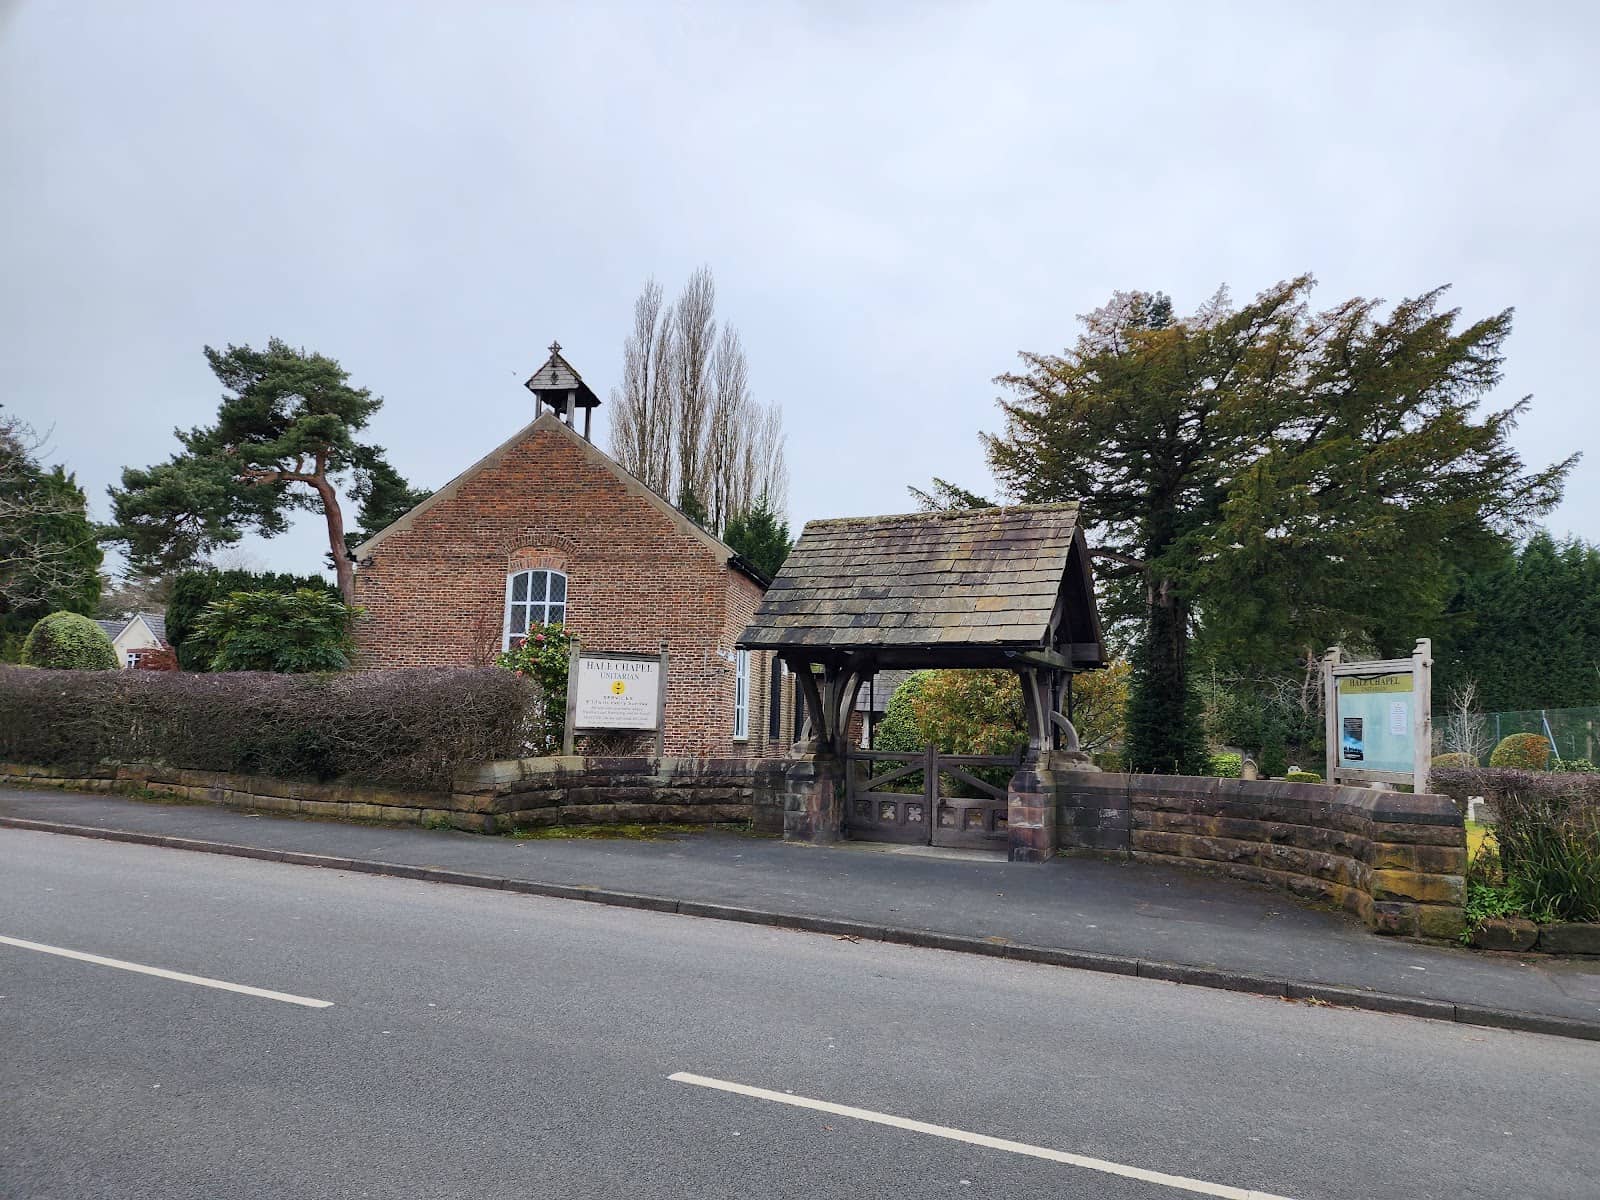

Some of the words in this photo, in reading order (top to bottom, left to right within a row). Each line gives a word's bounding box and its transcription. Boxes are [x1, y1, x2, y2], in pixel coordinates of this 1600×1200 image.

[586, 661, 612, 670] HALE
[615, 663, 653, 673] CHAPEL
[600, 672, 640, 680] UNITARIAN
